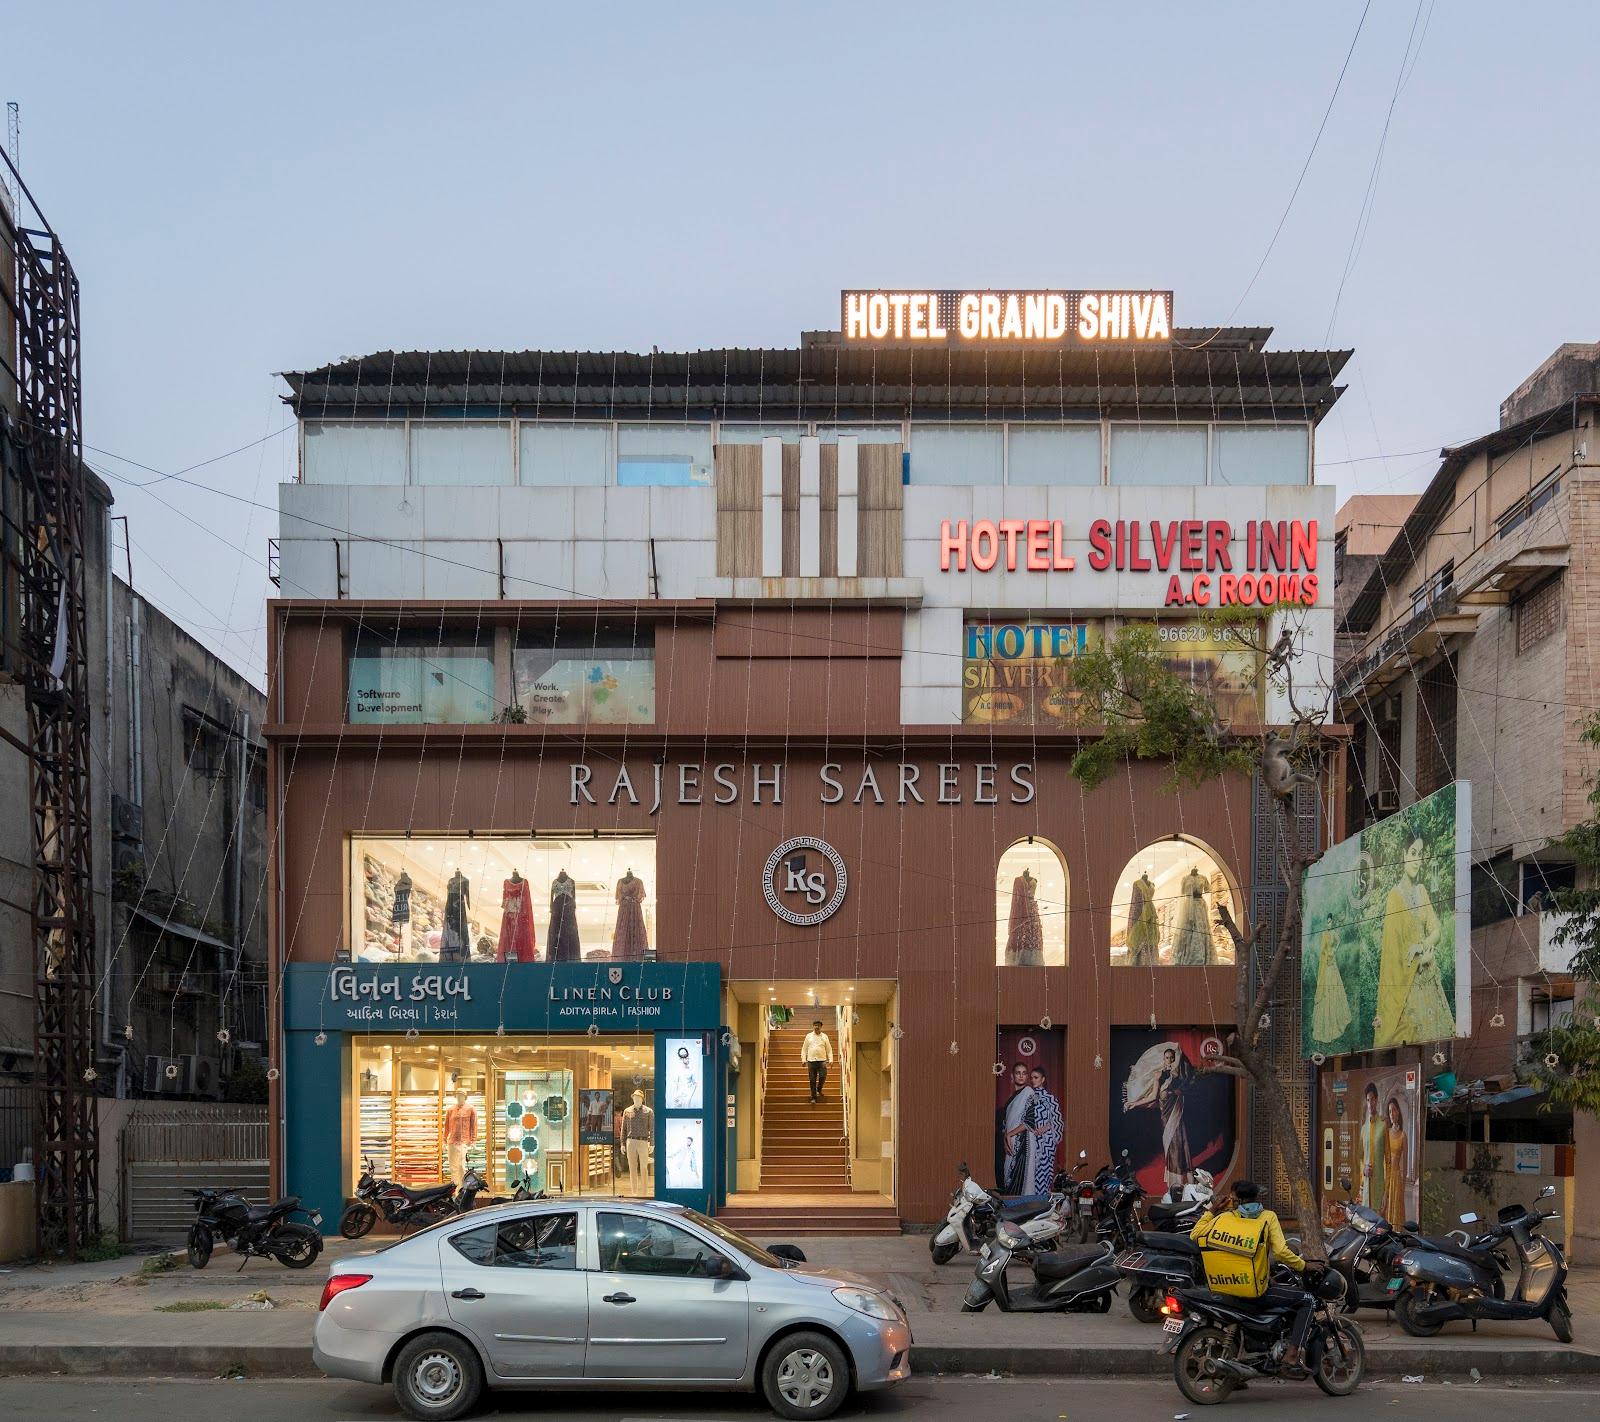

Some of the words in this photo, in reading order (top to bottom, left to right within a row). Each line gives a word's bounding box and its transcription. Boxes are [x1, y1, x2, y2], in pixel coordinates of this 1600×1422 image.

[847, 294, 946, 339] HOTEL
[959, 294, 1067, 339] GRAND
[1079, 294, 1170, 339] SHIVA
[940, 519, 1075, 572] HOTEL
[1088, 519, 1233, 572] SILVER
[1246, 519, 1319, 572] INN
[1165, 574, 1211, 606] A.C
[1219, 573, 1319, 606] ROOMS
[966, 624, 1090, 660] HOTEL
[1158, 626, 1208, 642] 96620
[534, 682, 559, 691] Work.
[964, 665, 1053, 688] SILVER
[357, 689, 401, 699] Software
[357, 703, 423, 714] Development
[569, 763, 783, 815] RAJESH
[820, 763, 1036, 804] SAREES
[331, 966, 402, 1001] લિનન
[550, 986, 612, 1001] LINEN
[619, 985, 673, 1001] CLUB
[559, 1006, 591, 1016] ADITYA
[592, 1006, 618, 1016] BIRLA
[628, 1006, 661, 1016] FASHION
[1211, 1229, 1255, 1249] blinkit
[1208, 1271, 1251, 1286] blinkit
